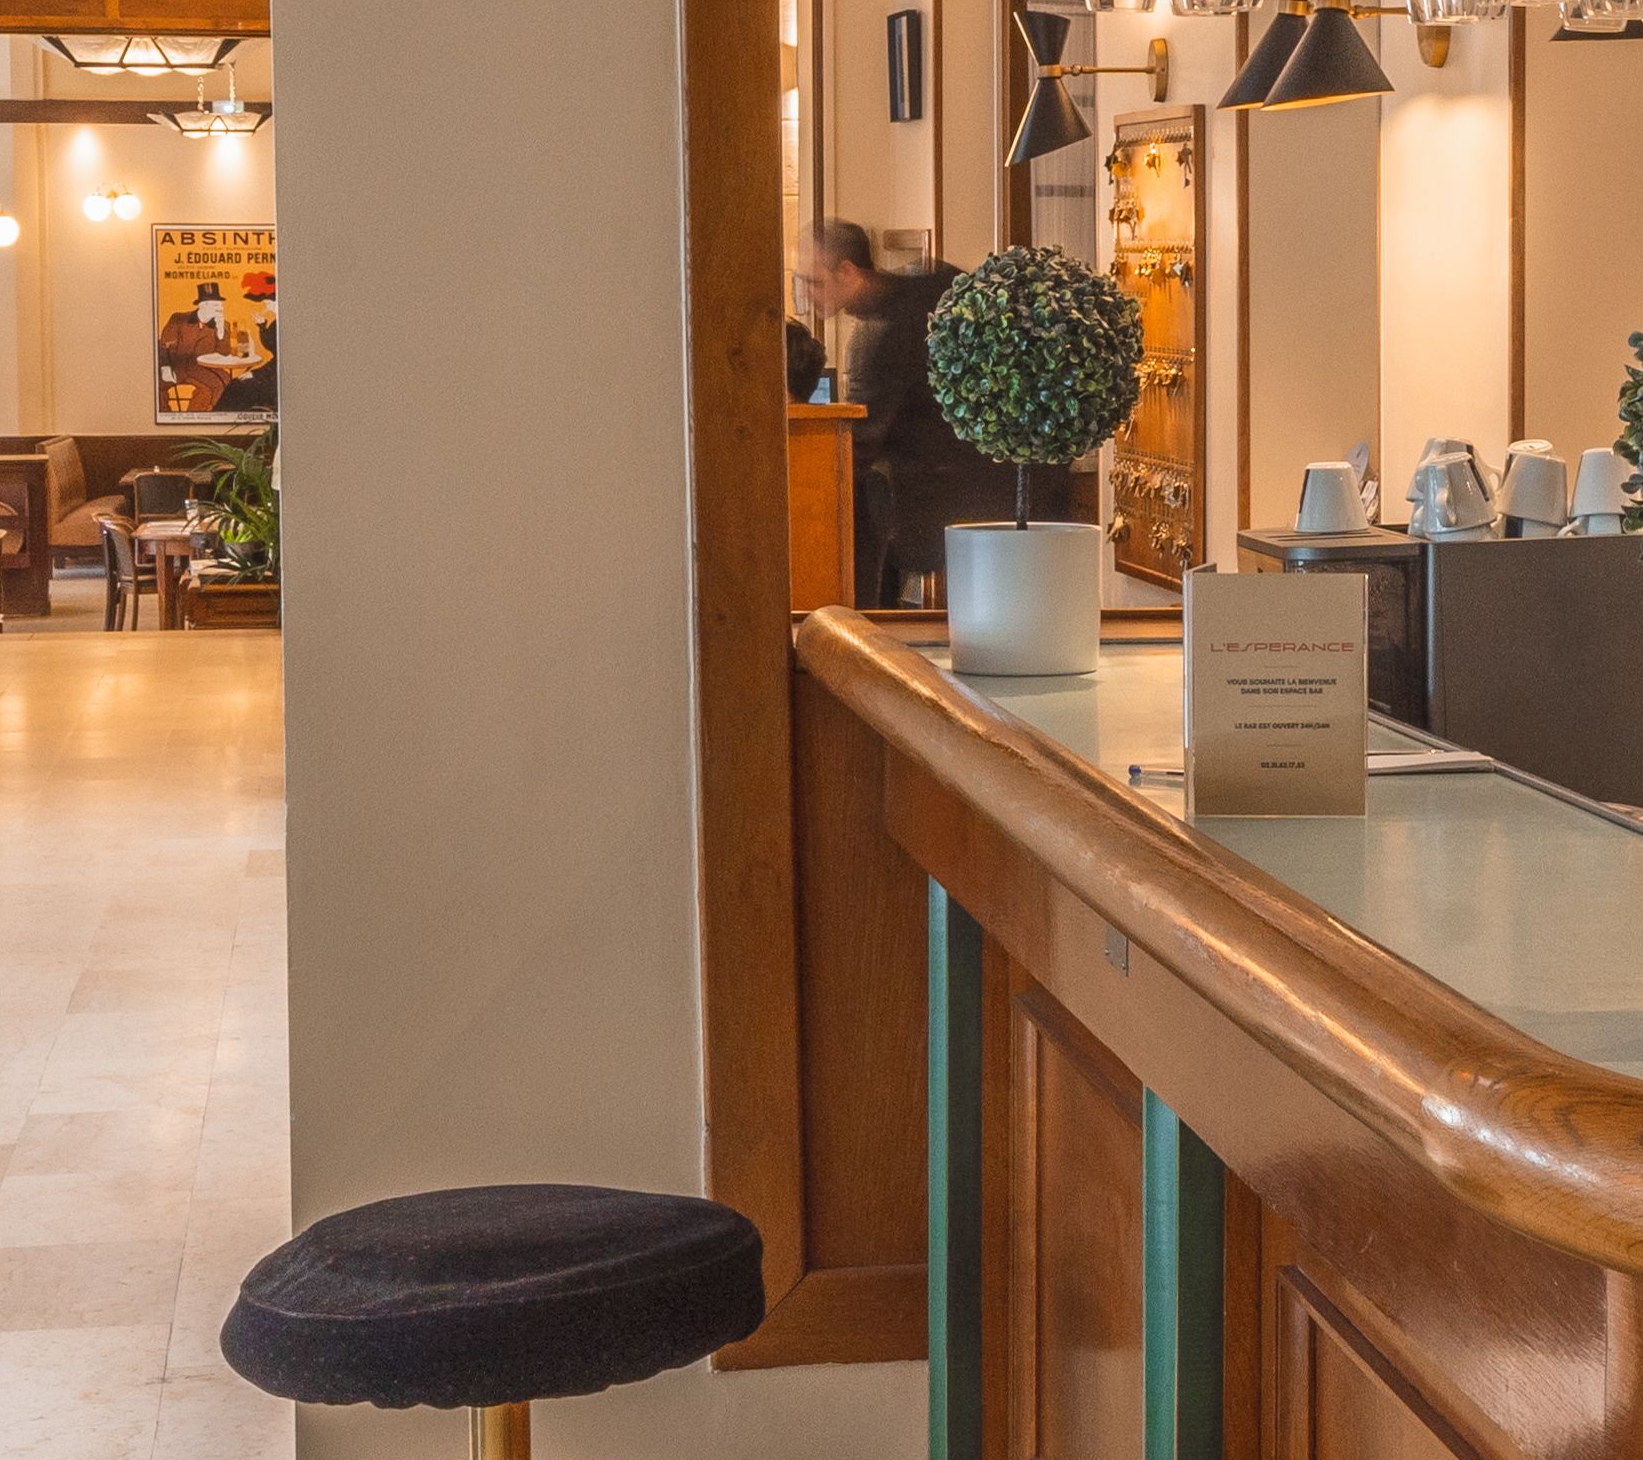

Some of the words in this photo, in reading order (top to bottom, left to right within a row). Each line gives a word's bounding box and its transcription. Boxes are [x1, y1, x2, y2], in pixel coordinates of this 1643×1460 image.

[160, 232, 275, 245] ABSINTH
[174, 253, 184, 264] J.
[187, 251, 242, 264] ÉDOUARD
[247, 253, 275, 264] PERN
[164, 270, 231, 280] MONTBÉLIARD
[1210, 642, 1355, 653] L'ESPERANCE
[1227, 678, 1248, 686] VOUS
[1250, 678, 1286, 686] SOUHAITE
[1288, 678, 1297, 686] LA
[1299, 678, 1337, 686] BIENVENUE
